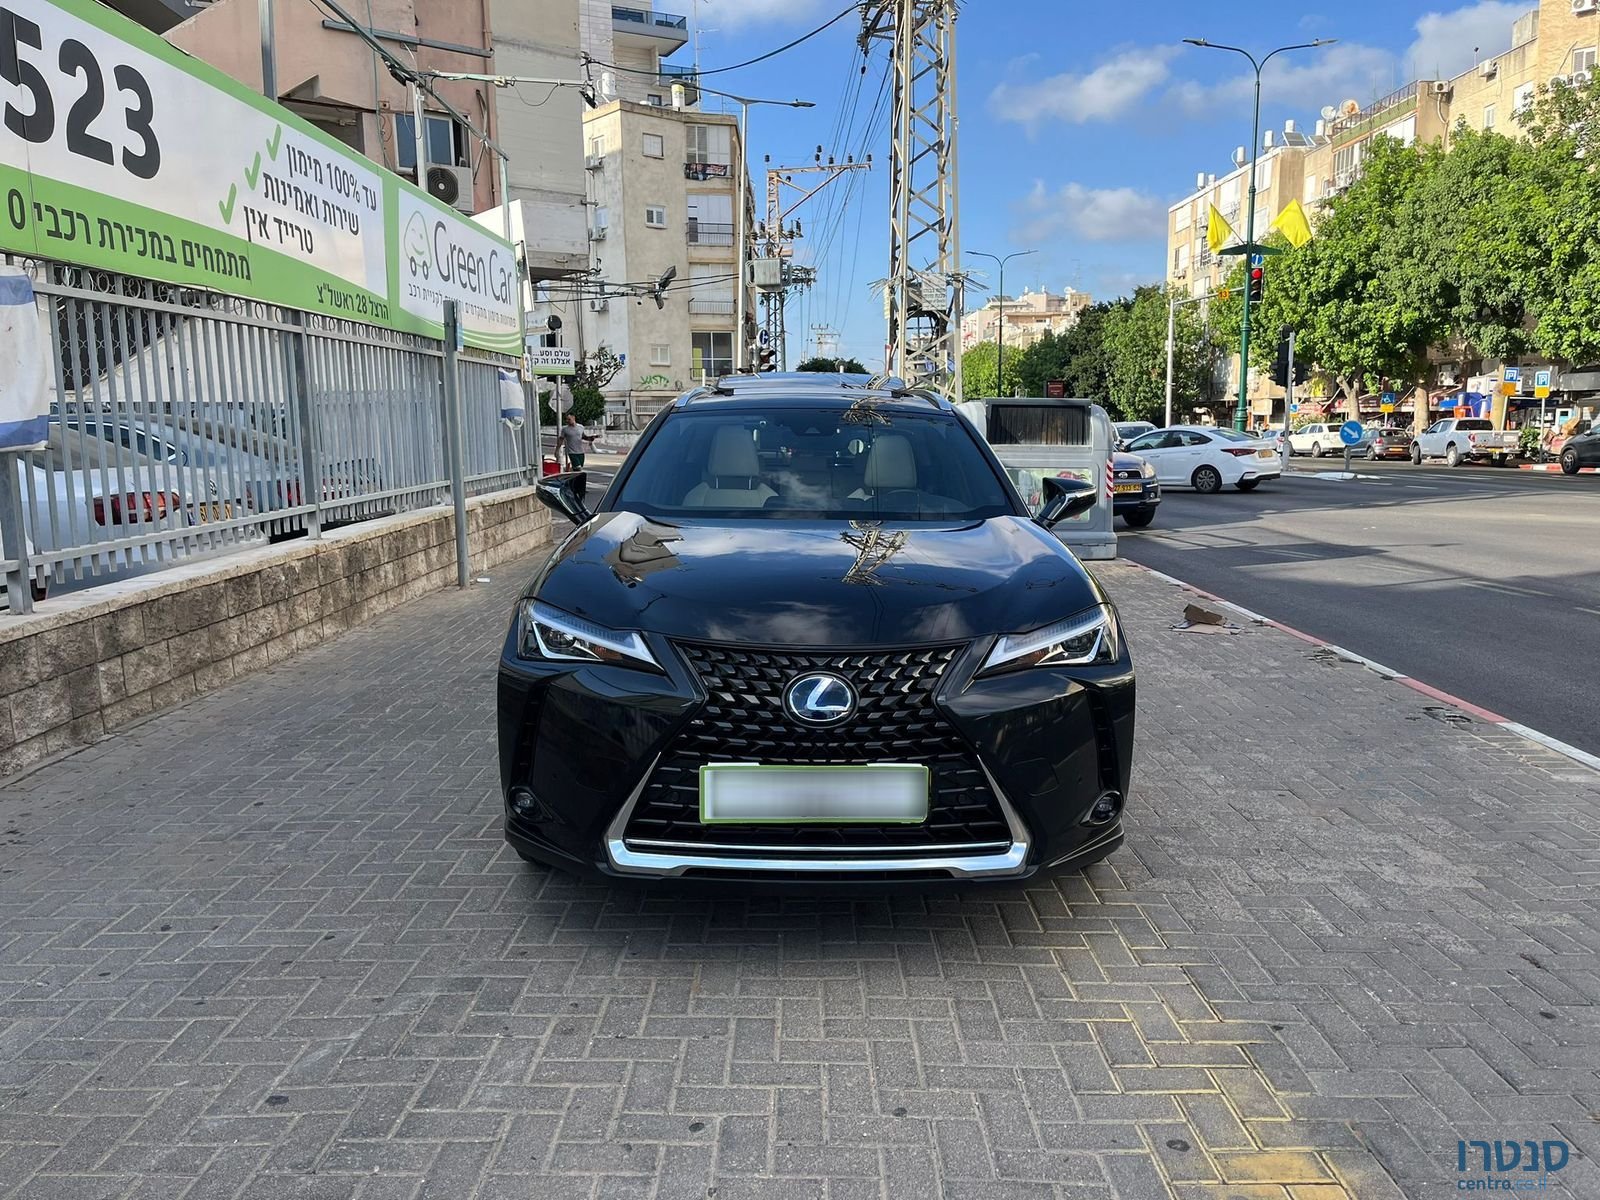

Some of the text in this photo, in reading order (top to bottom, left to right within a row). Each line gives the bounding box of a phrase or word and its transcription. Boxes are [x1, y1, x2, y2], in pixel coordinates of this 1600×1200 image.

[0, 6, 161, 180] 523
[286, 144, 377, 212] עד 100% מימון
[33, 202, 92, 245] רכבי
[263, 172, 359, 236] שירות ואמינות
[97, 217, 178, 264] במכירת
[243, 206, 314, 254] טרייד אין
[181, 239, 252, 281] מתמחים
[434, 220, 512, 306] Green Car
[355, 293, 368, 314] 28
[368, 295, 389, 321] הרצל
[408, 283, 421, 299] רכב
[541, 357, 549, 365] זה
[551, 357, 571, 365] אצלנו
[554, 350, 571, 358] שלם
